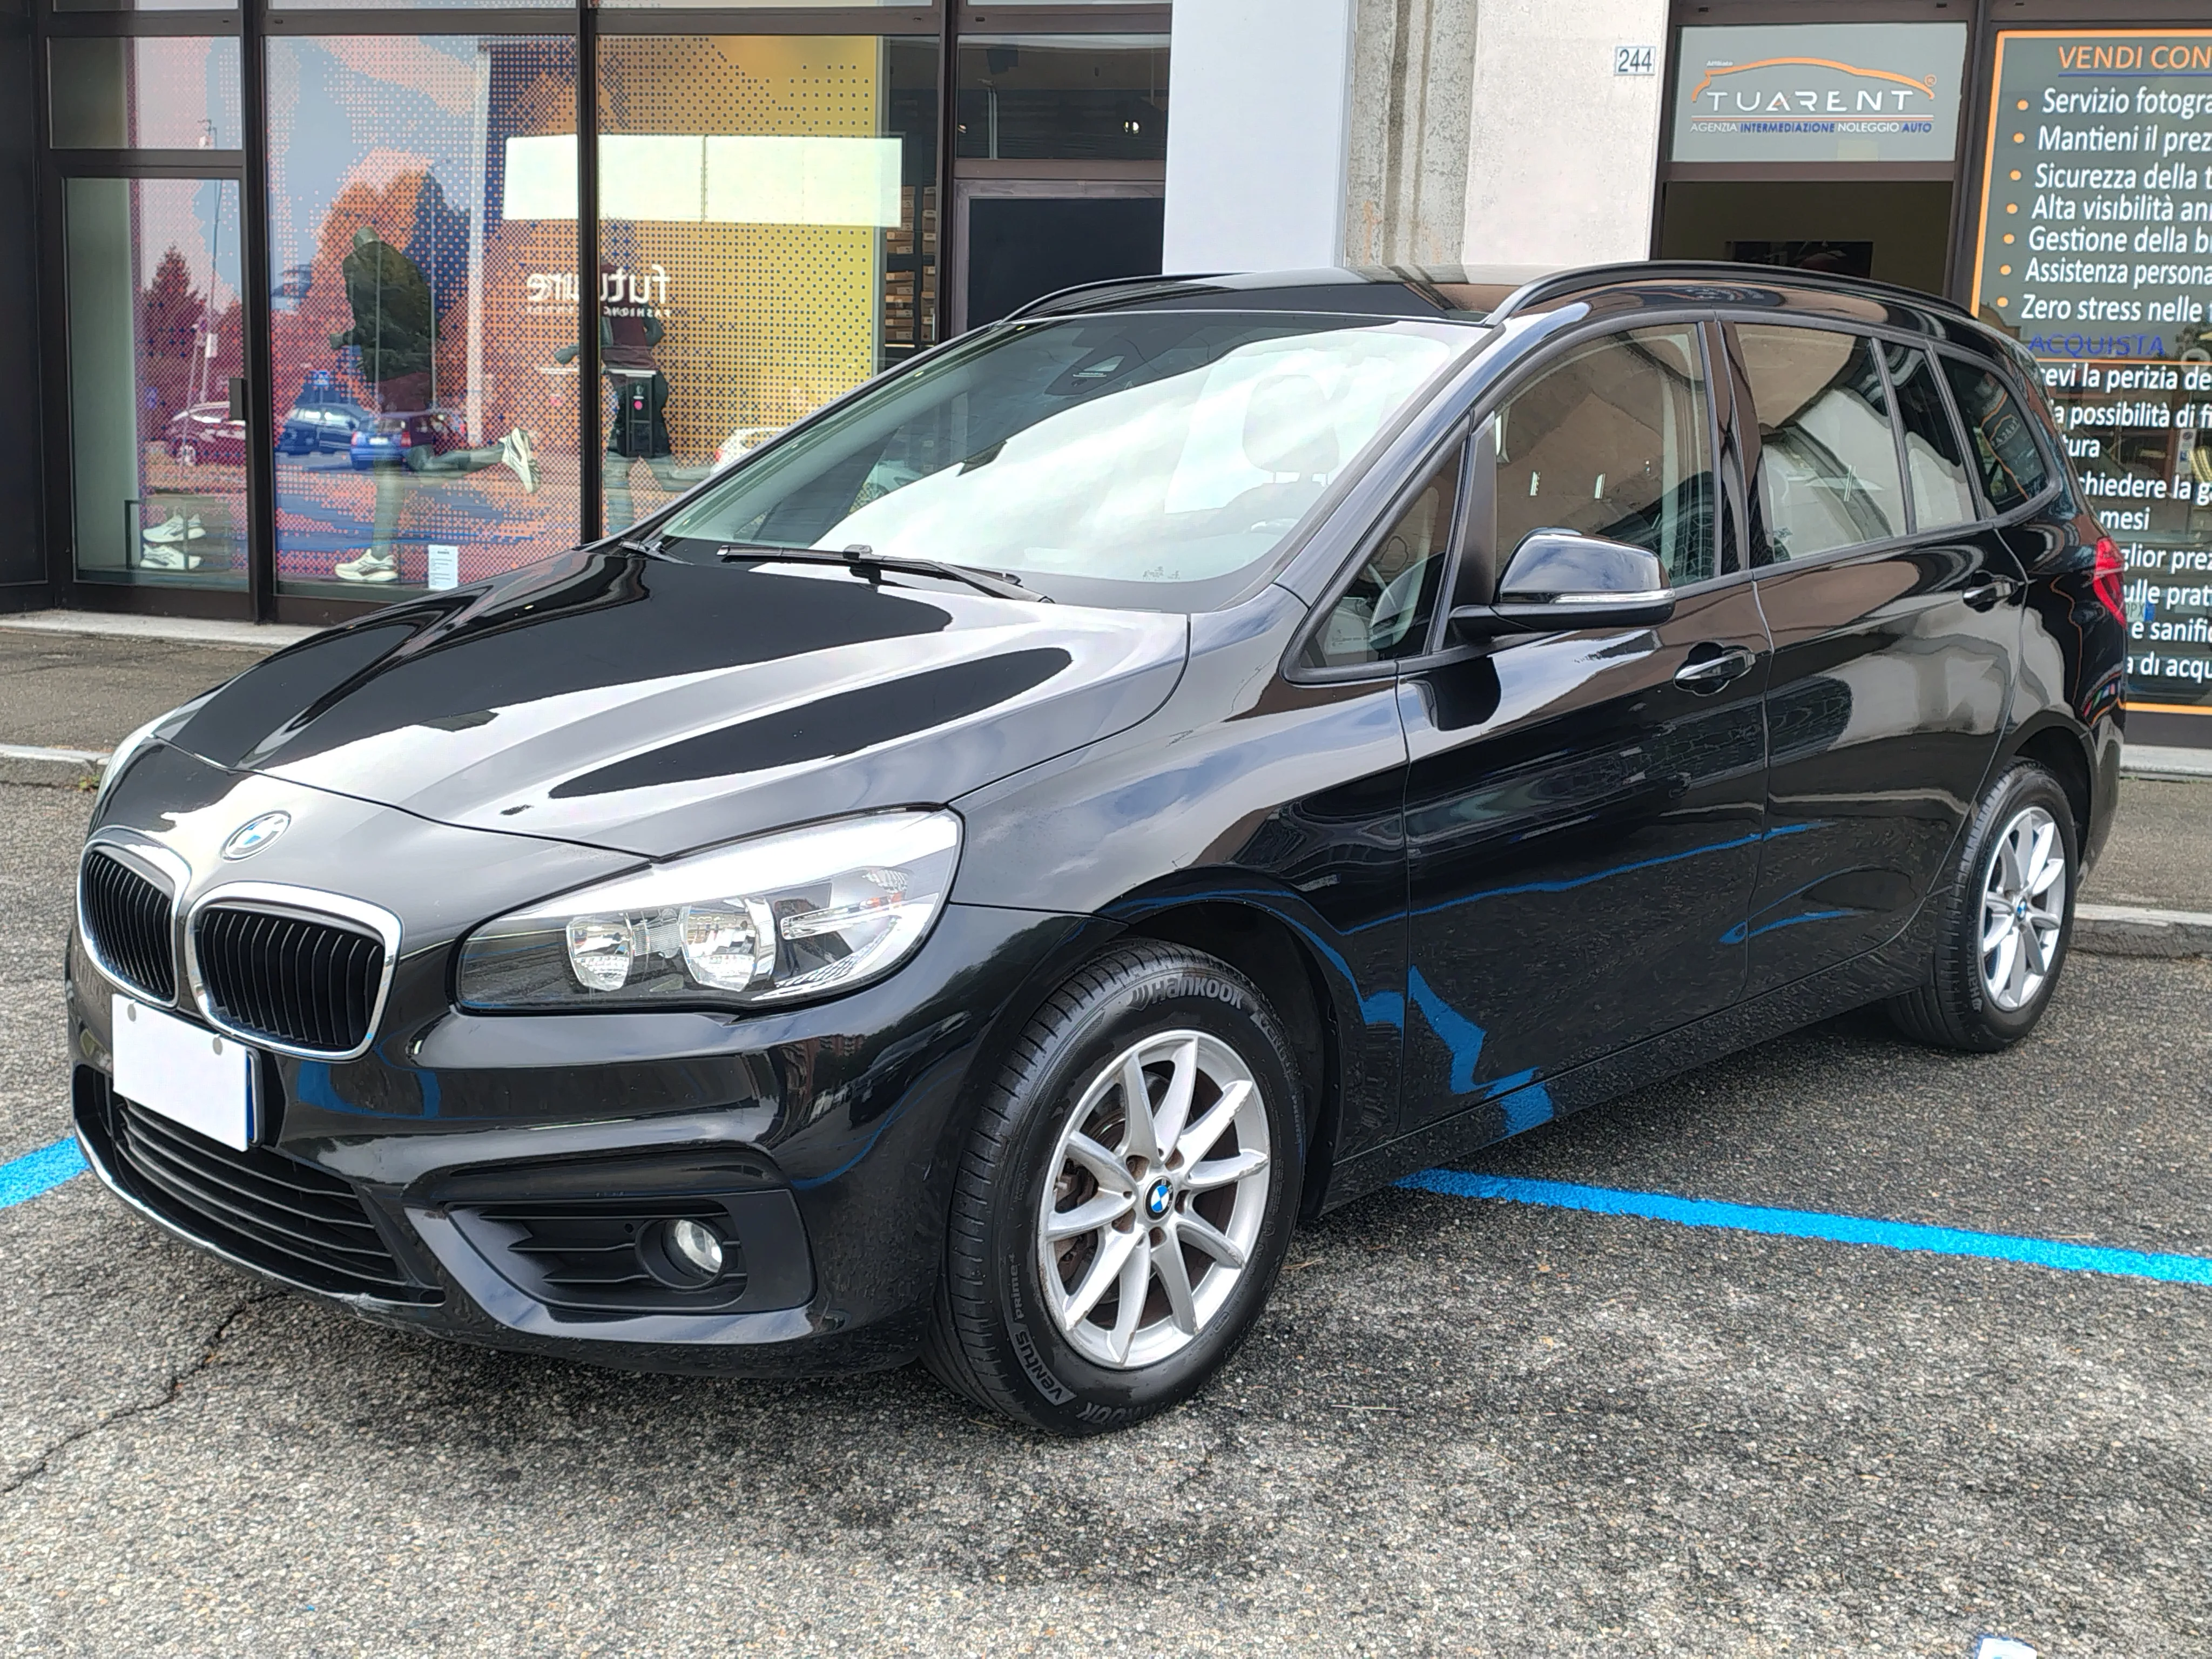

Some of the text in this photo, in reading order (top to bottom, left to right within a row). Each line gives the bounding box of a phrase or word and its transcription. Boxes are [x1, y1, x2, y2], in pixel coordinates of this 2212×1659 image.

[1617, 50, 1652, 72] 244
[2058, 45, 2212, 69] VENDI CON
[1705, 90, 1913, 112] TUARENT
[2042, 87, 2129, 113] Servizio
[1690, 122, 1932, 133] AGENZIA INTERMEDIAZIONE NOLEGGIO AUTO
[2038, 125, 2139, 151] Mantieni
[2144, 124, 2158, 151] il
[2035, 162, 2136, 189] Sicurezza
[2143, 162, 2197, 190] della
[2031, 193, 2076, 220] Alta
[2083, 193, 2174, 221] visibilità
[2029, 225, 2127, 252] Gestione
[2134, 225, 2188, 253] della
[2025, 257, 2128, 284] Assistenza
[2021, 293, 2071, 320] Zero
[2077, 296, 2141, 321] stress
[2148, 295, 2202, 322] nelle
[2028, 333, 2166, 359] ACQUISTA
[2040, 363, 2076, 386] evi
[2082, 362, 2100, 387] la
[2106, 365, 2177, 393] perizia
[2050, 399, 2065, 423] a
[2070, 401, 2170, 430] possibilità
[2176, 403, 2195, 428] di
[2173, 474, 2191, 500] la
[2100, 507, 2150, 530] mesi
[2132, 621, 2144, 639] e
[2140, 651, 2160, 675] di
